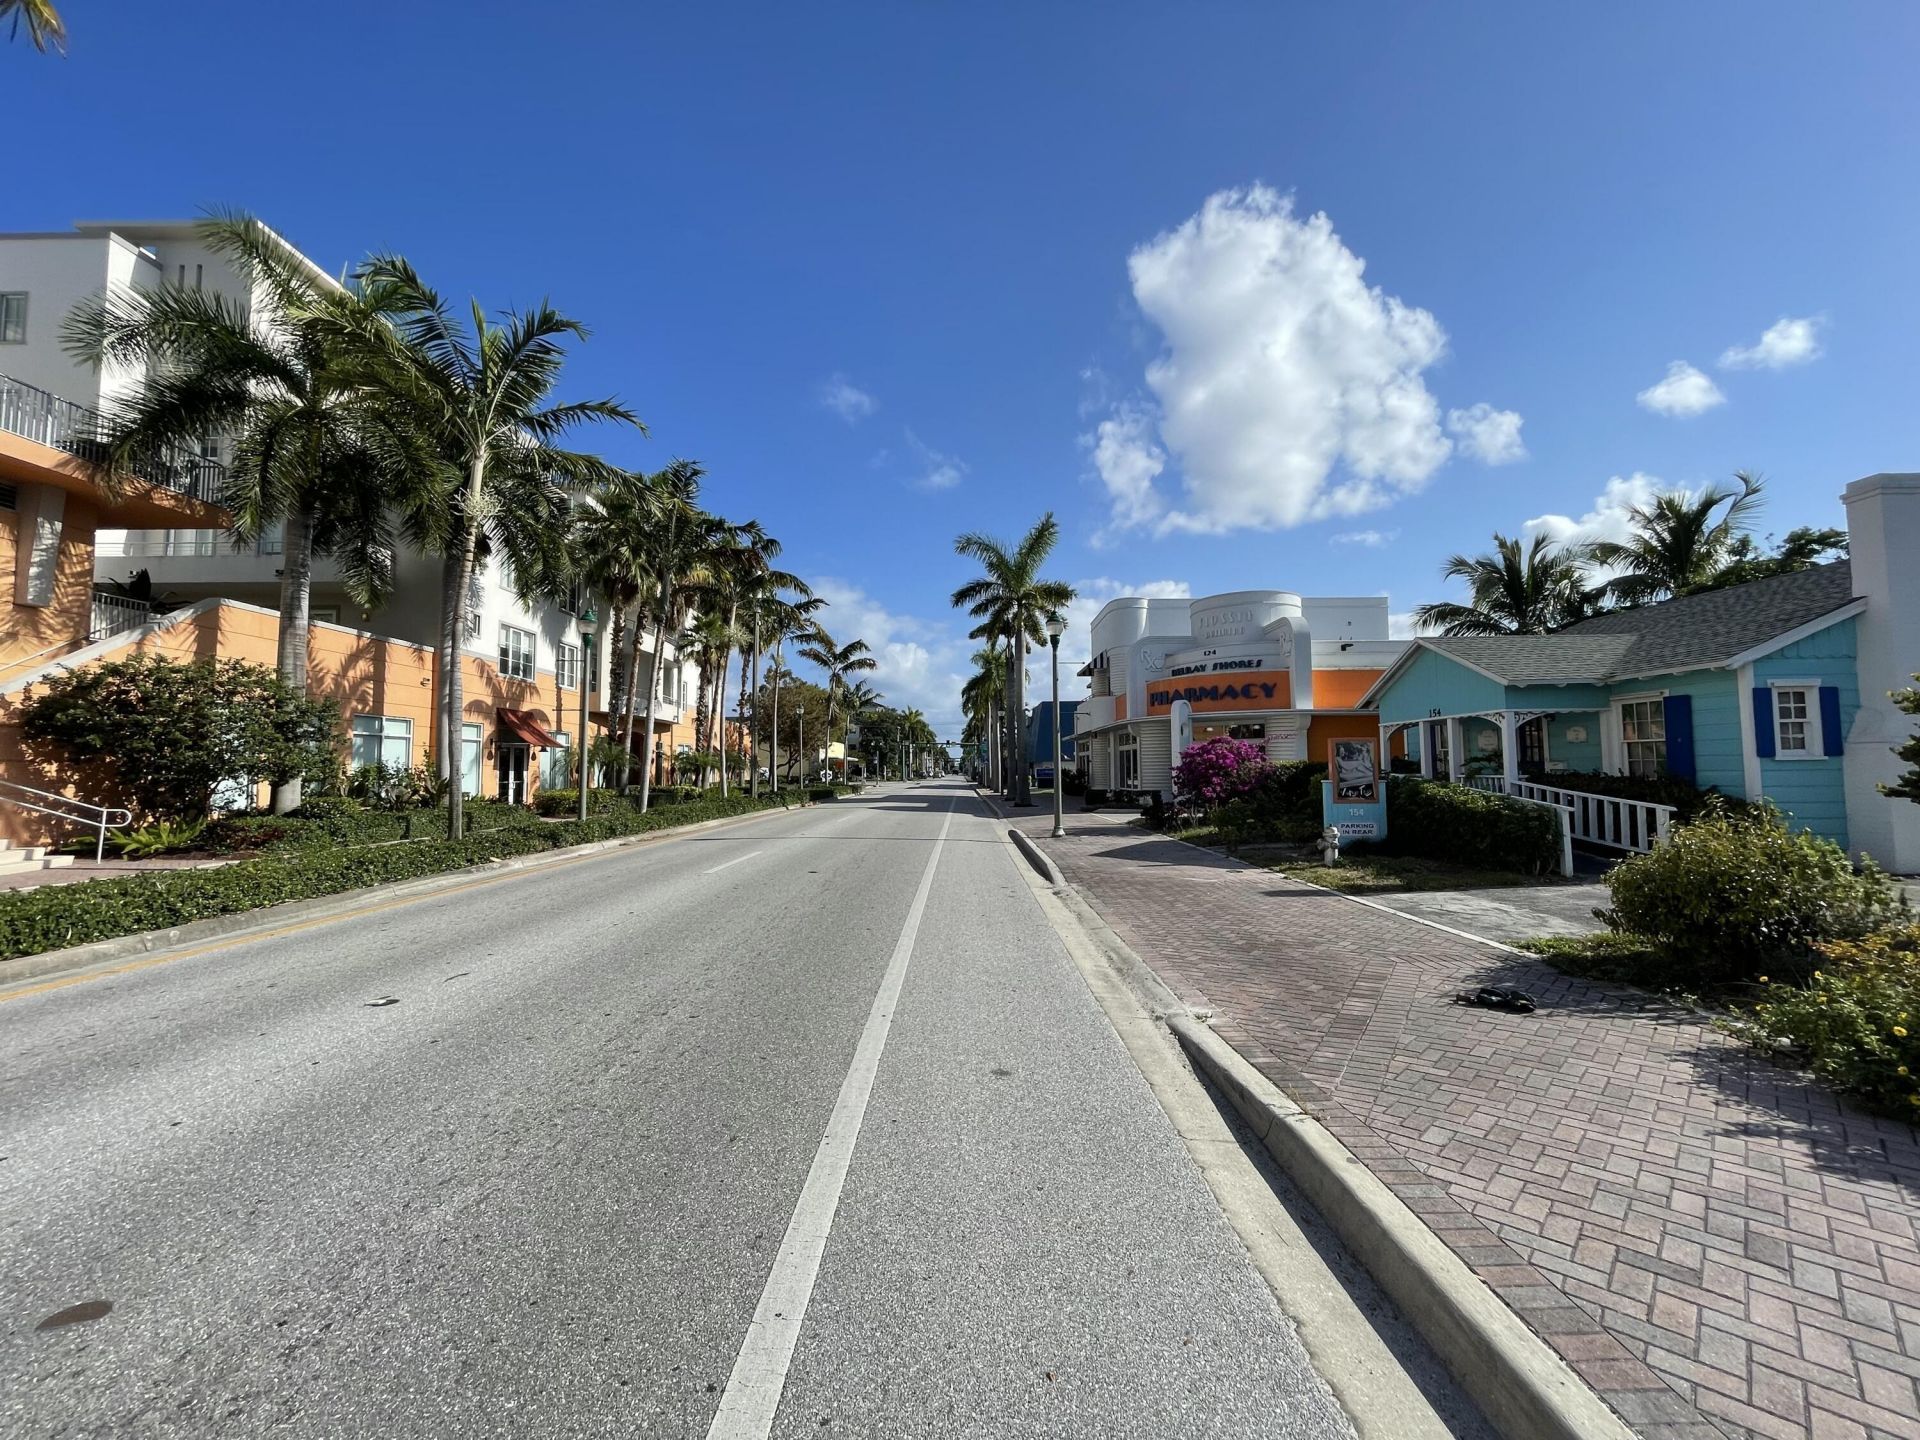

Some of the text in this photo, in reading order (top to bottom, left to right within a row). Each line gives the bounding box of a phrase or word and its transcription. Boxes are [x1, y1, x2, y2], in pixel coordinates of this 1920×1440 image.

[1171, 659, 1263, 677] DELRAY SHORES
[1150, 682, 1278, 707] PHARMACY
[1429, 708, 1441, 718] 154
